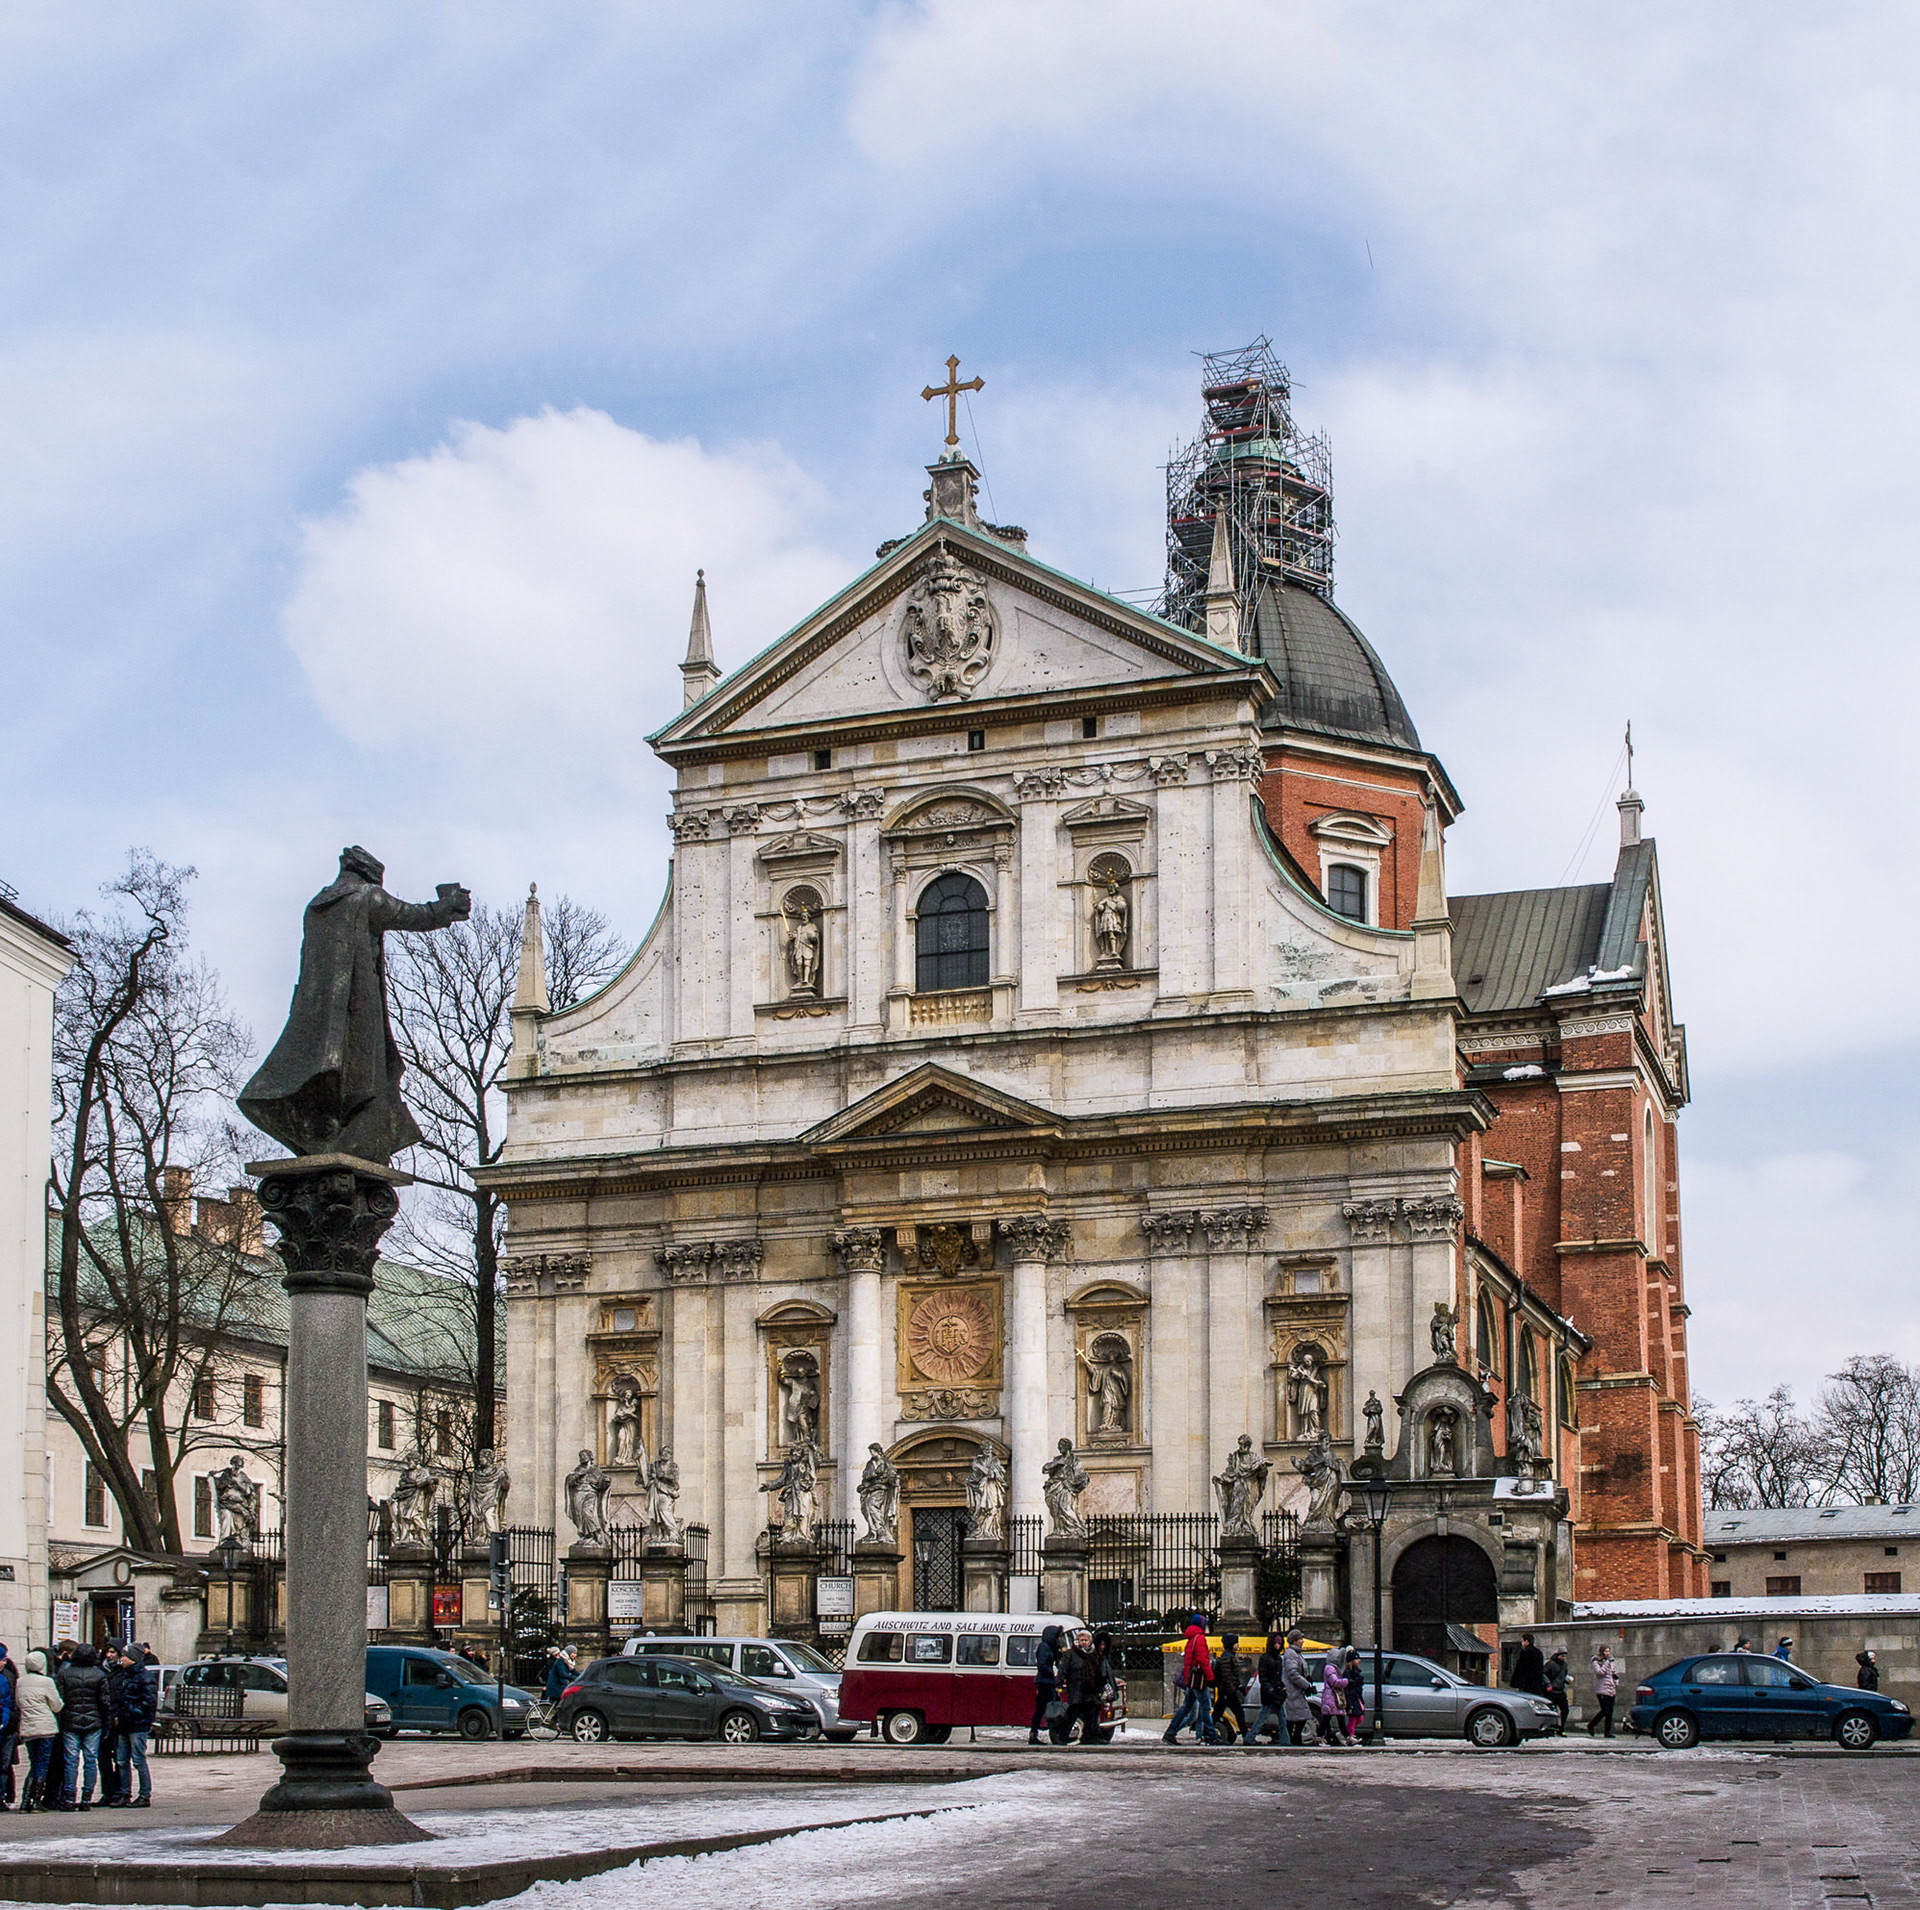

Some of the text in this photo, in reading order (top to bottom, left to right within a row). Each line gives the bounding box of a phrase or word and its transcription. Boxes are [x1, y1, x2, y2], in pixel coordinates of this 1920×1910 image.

[874, 1621, 1034, 1632] AUSCHWITZ AND SALT MINE TOUR
